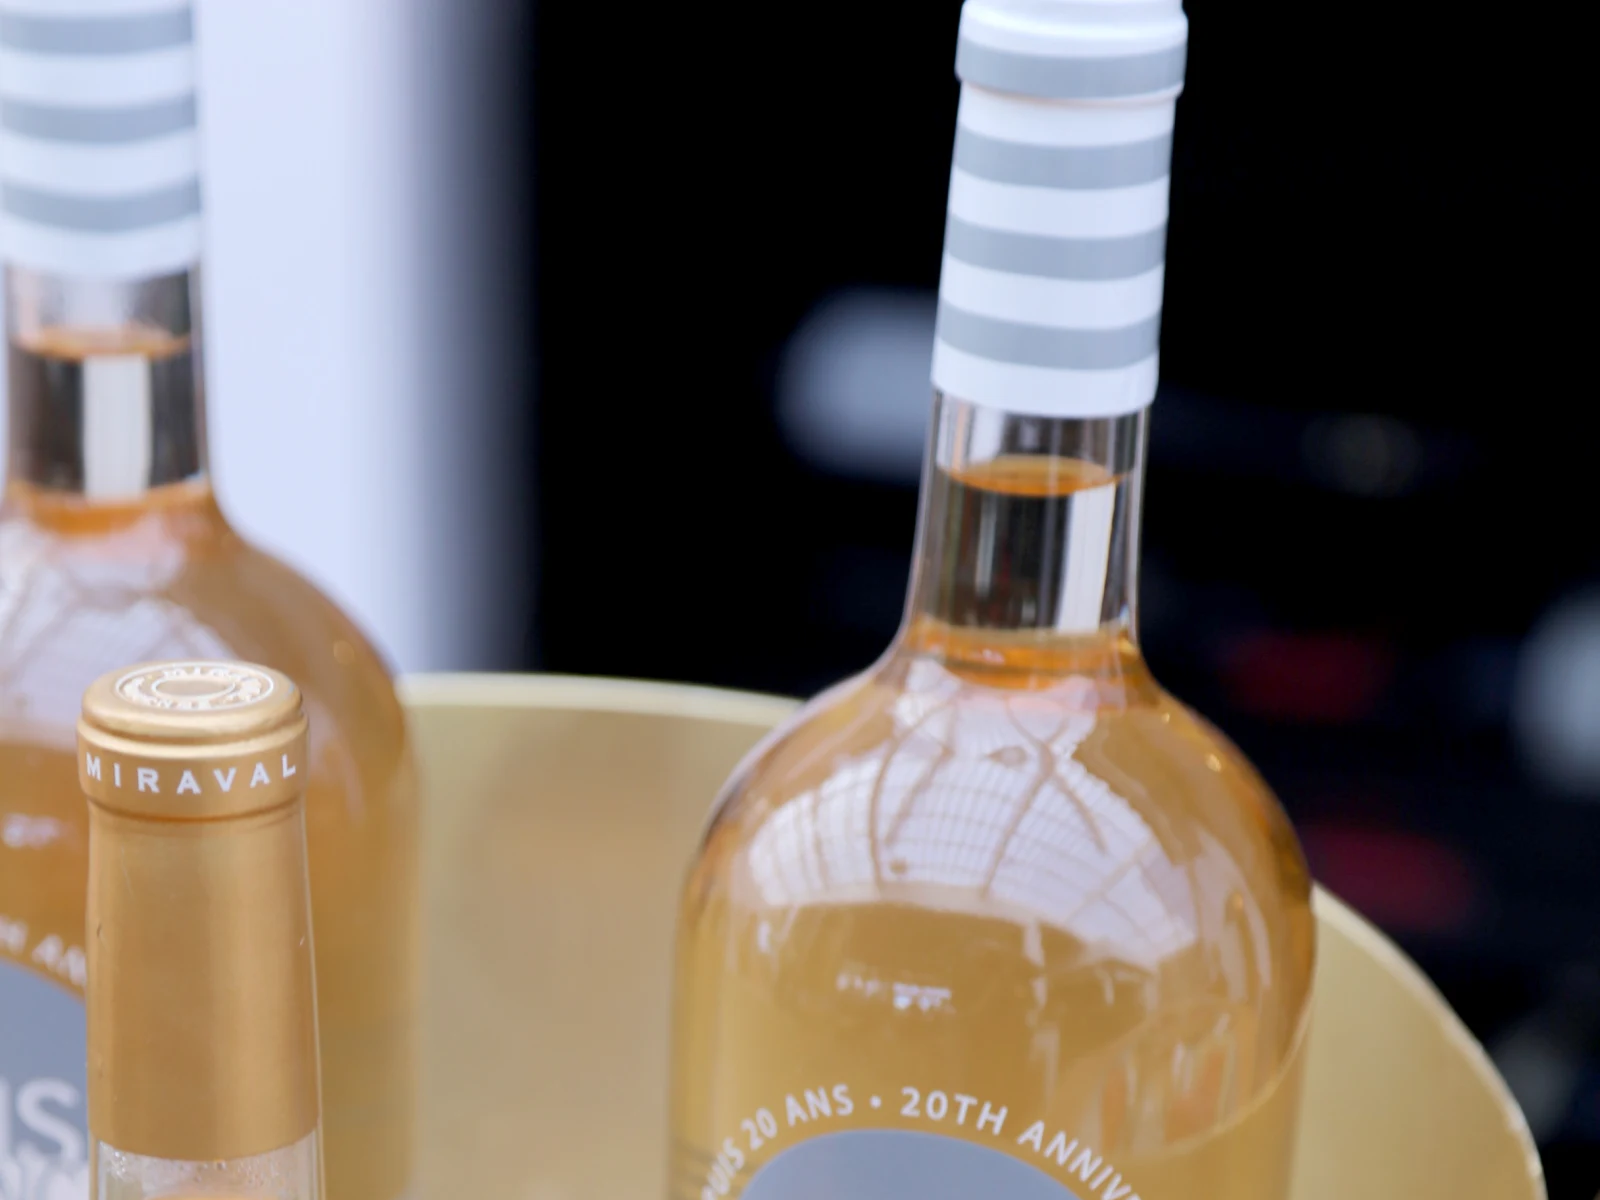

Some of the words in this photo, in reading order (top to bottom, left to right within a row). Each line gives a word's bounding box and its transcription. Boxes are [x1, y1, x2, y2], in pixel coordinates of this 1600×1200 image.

[85, 751, 297, 795] MIRAVAL
[740, 1106, 778, 1151] 20
[784, 1082, 855, 1128] ANS
[900, 1085, 1009, 1136] 20TH
